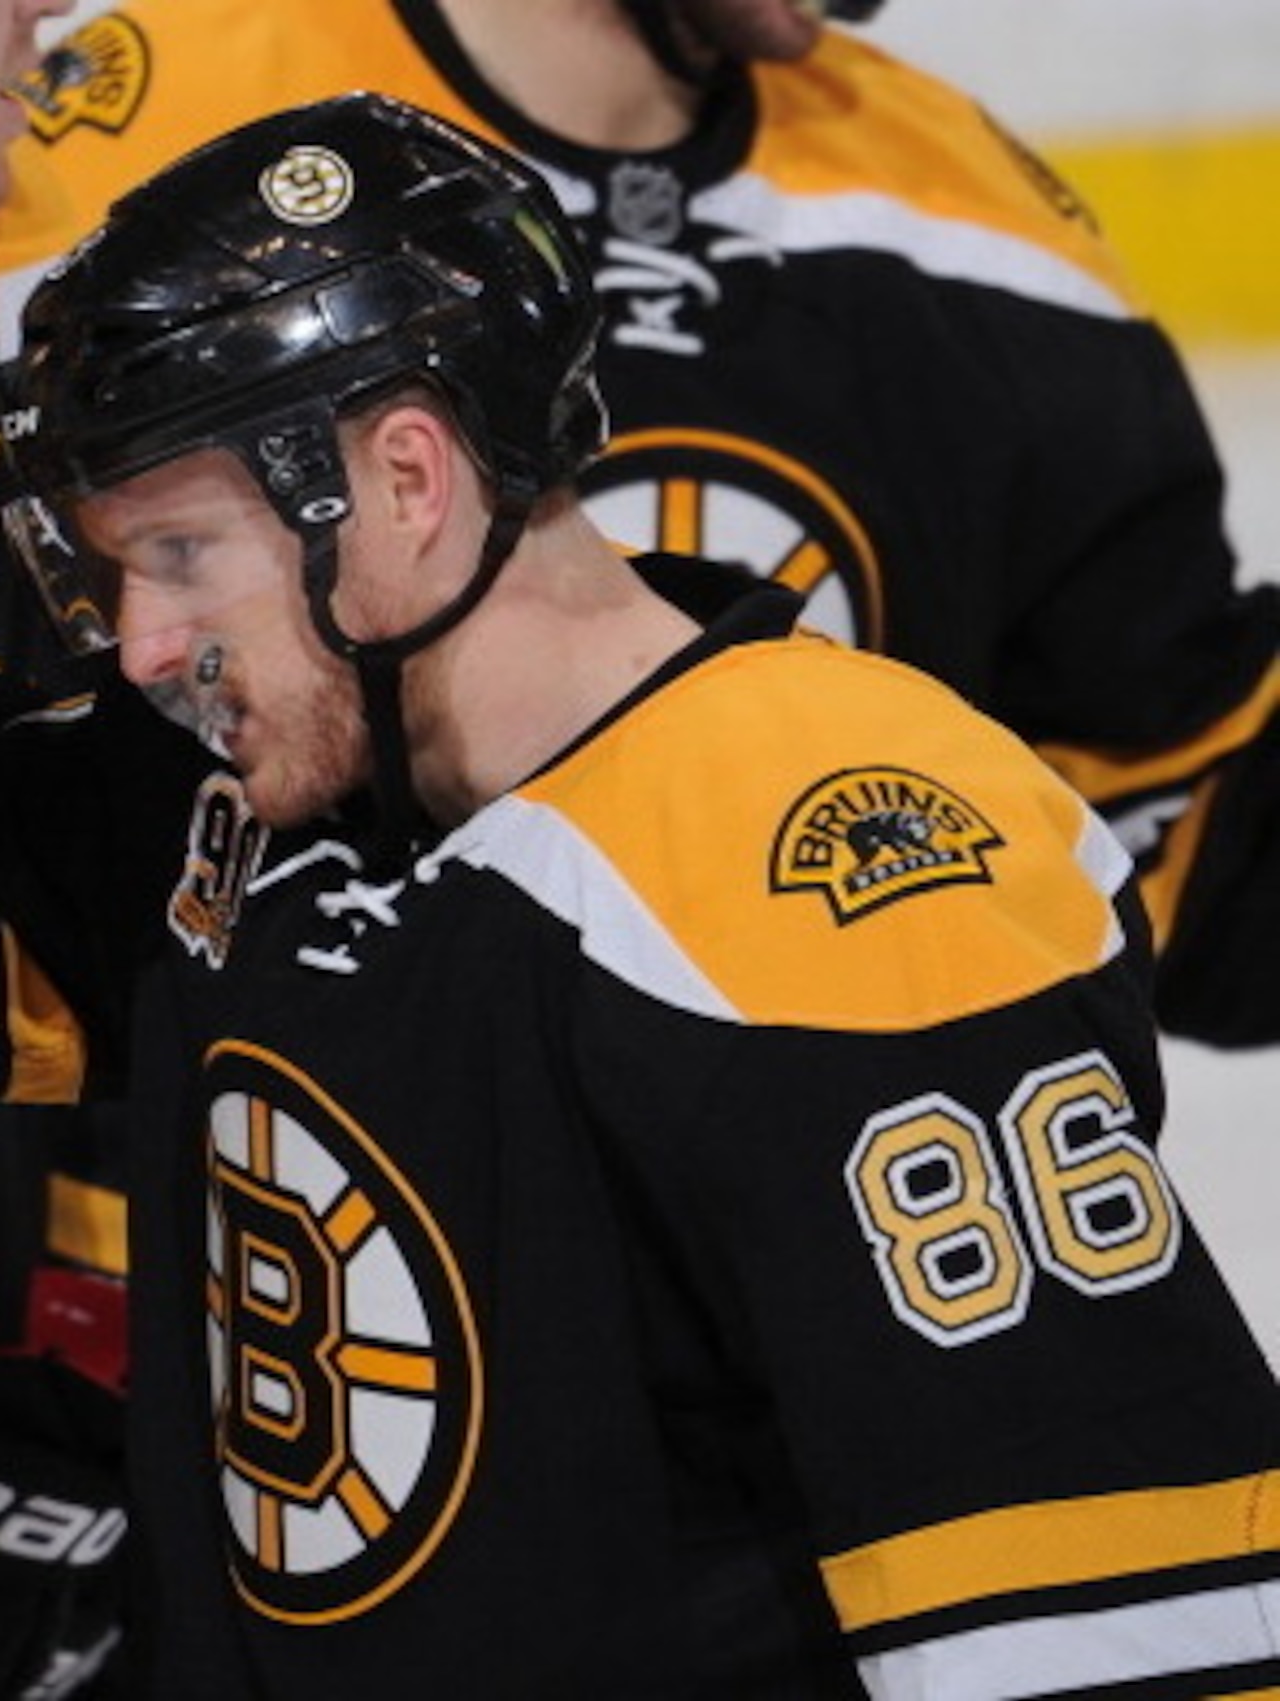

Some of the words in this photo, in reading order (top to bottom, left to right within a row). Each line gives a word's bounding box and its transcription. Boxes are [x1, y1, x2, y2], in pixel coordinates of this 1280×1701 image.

[792, 781, 971, 869] BRUINS
[208, 1155, 347, 1508] B
[845, 1049, 1183, 1348] 86
